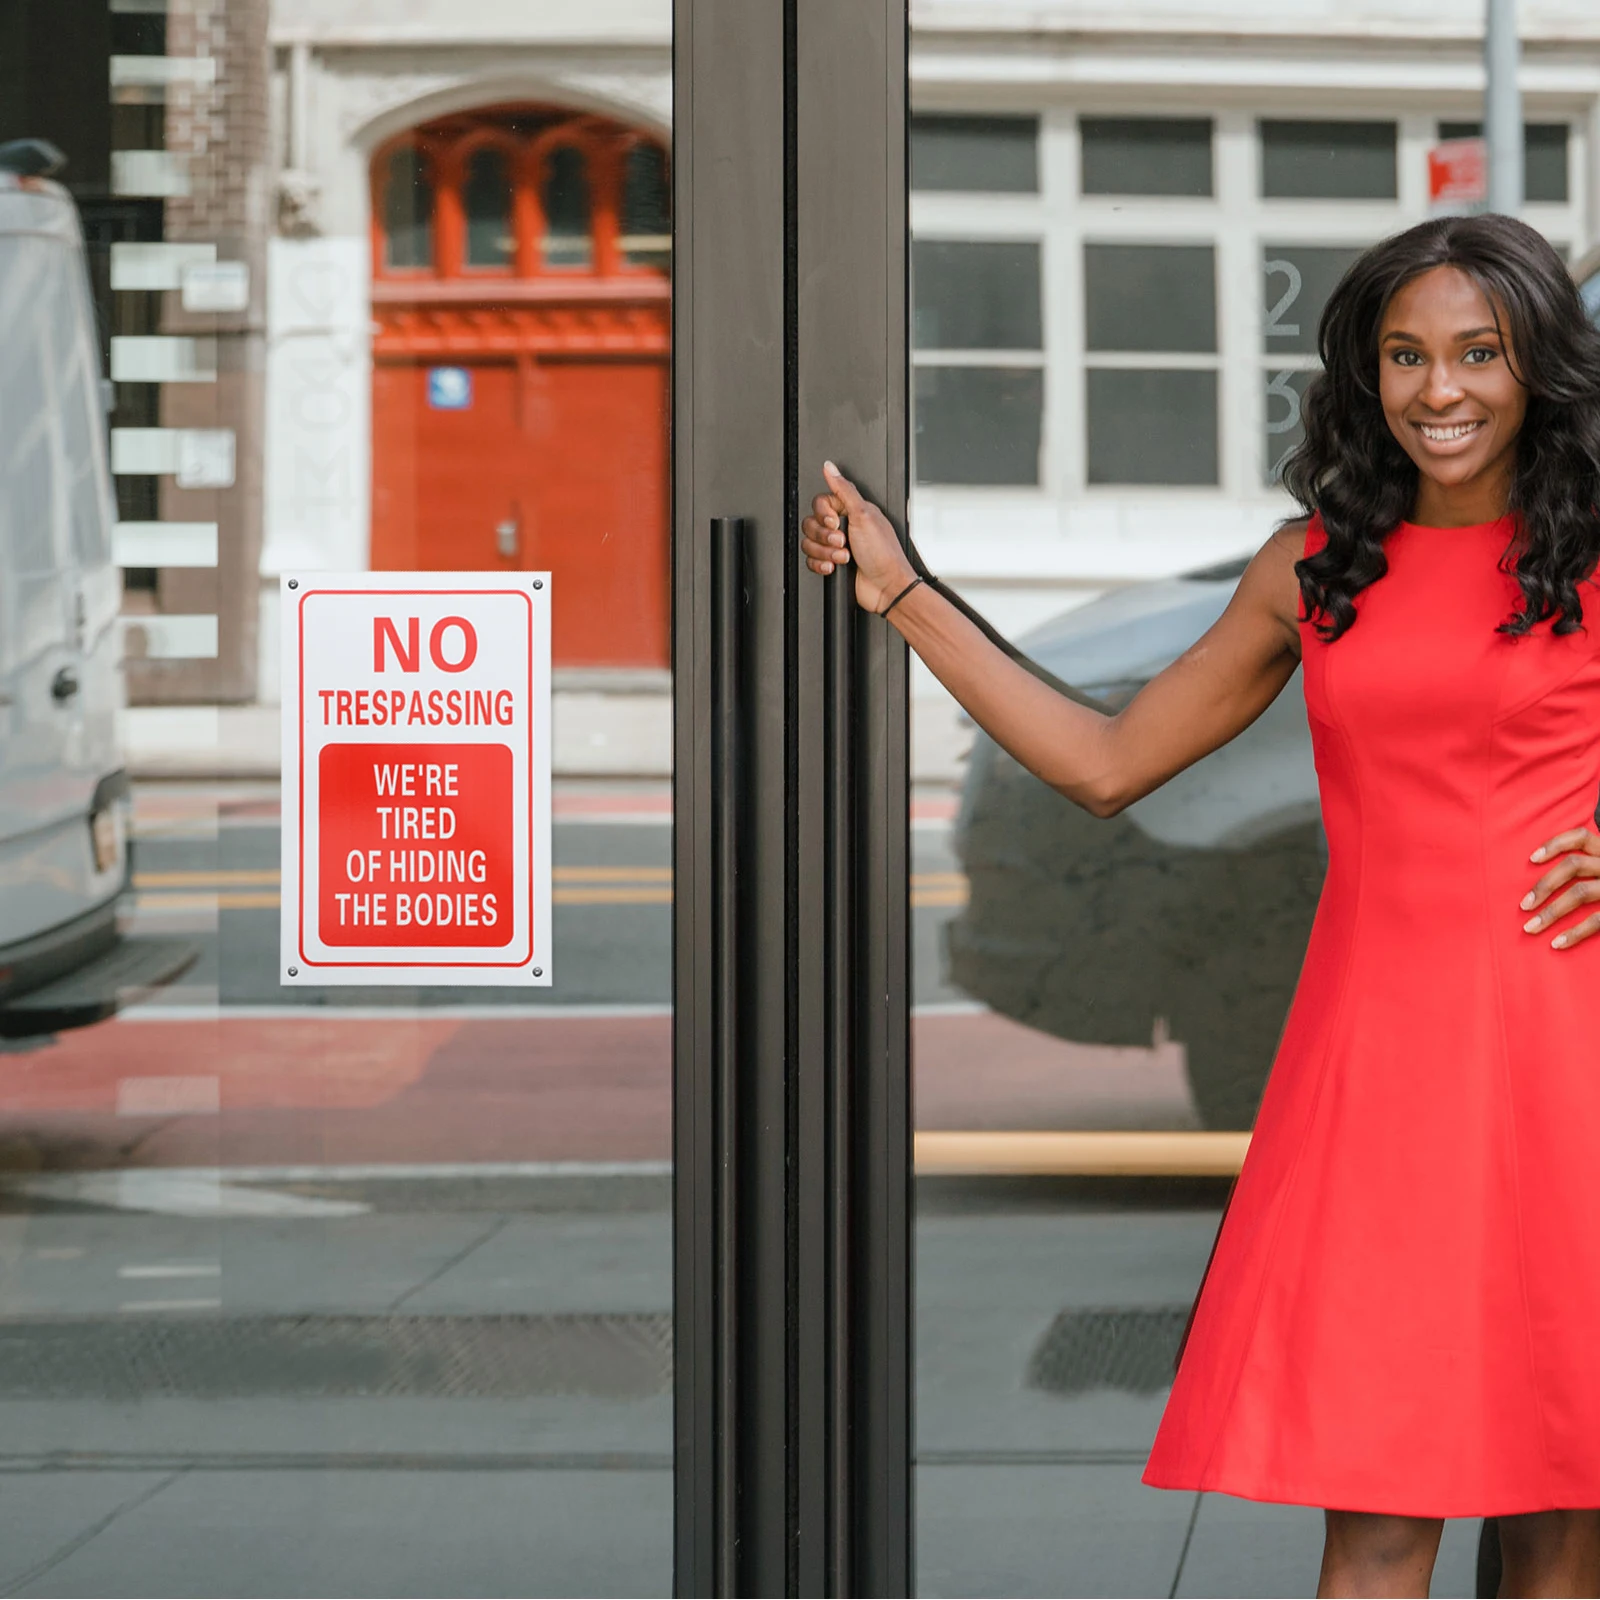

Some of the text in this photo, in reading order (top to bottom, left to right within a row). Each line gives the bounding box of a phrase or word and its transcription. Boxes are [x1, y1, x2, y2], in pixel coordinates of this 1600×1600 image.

[373, 615, 478, 673] NO
[318, 689, 514, 726] TRESPASSING
[373, 763, 459, 796] WE'RE
[376, 806, 456, 840] TIRED
[346, 849, 487, 884] OF HIDING
[334, 892, 498, 927] THE BODIES
